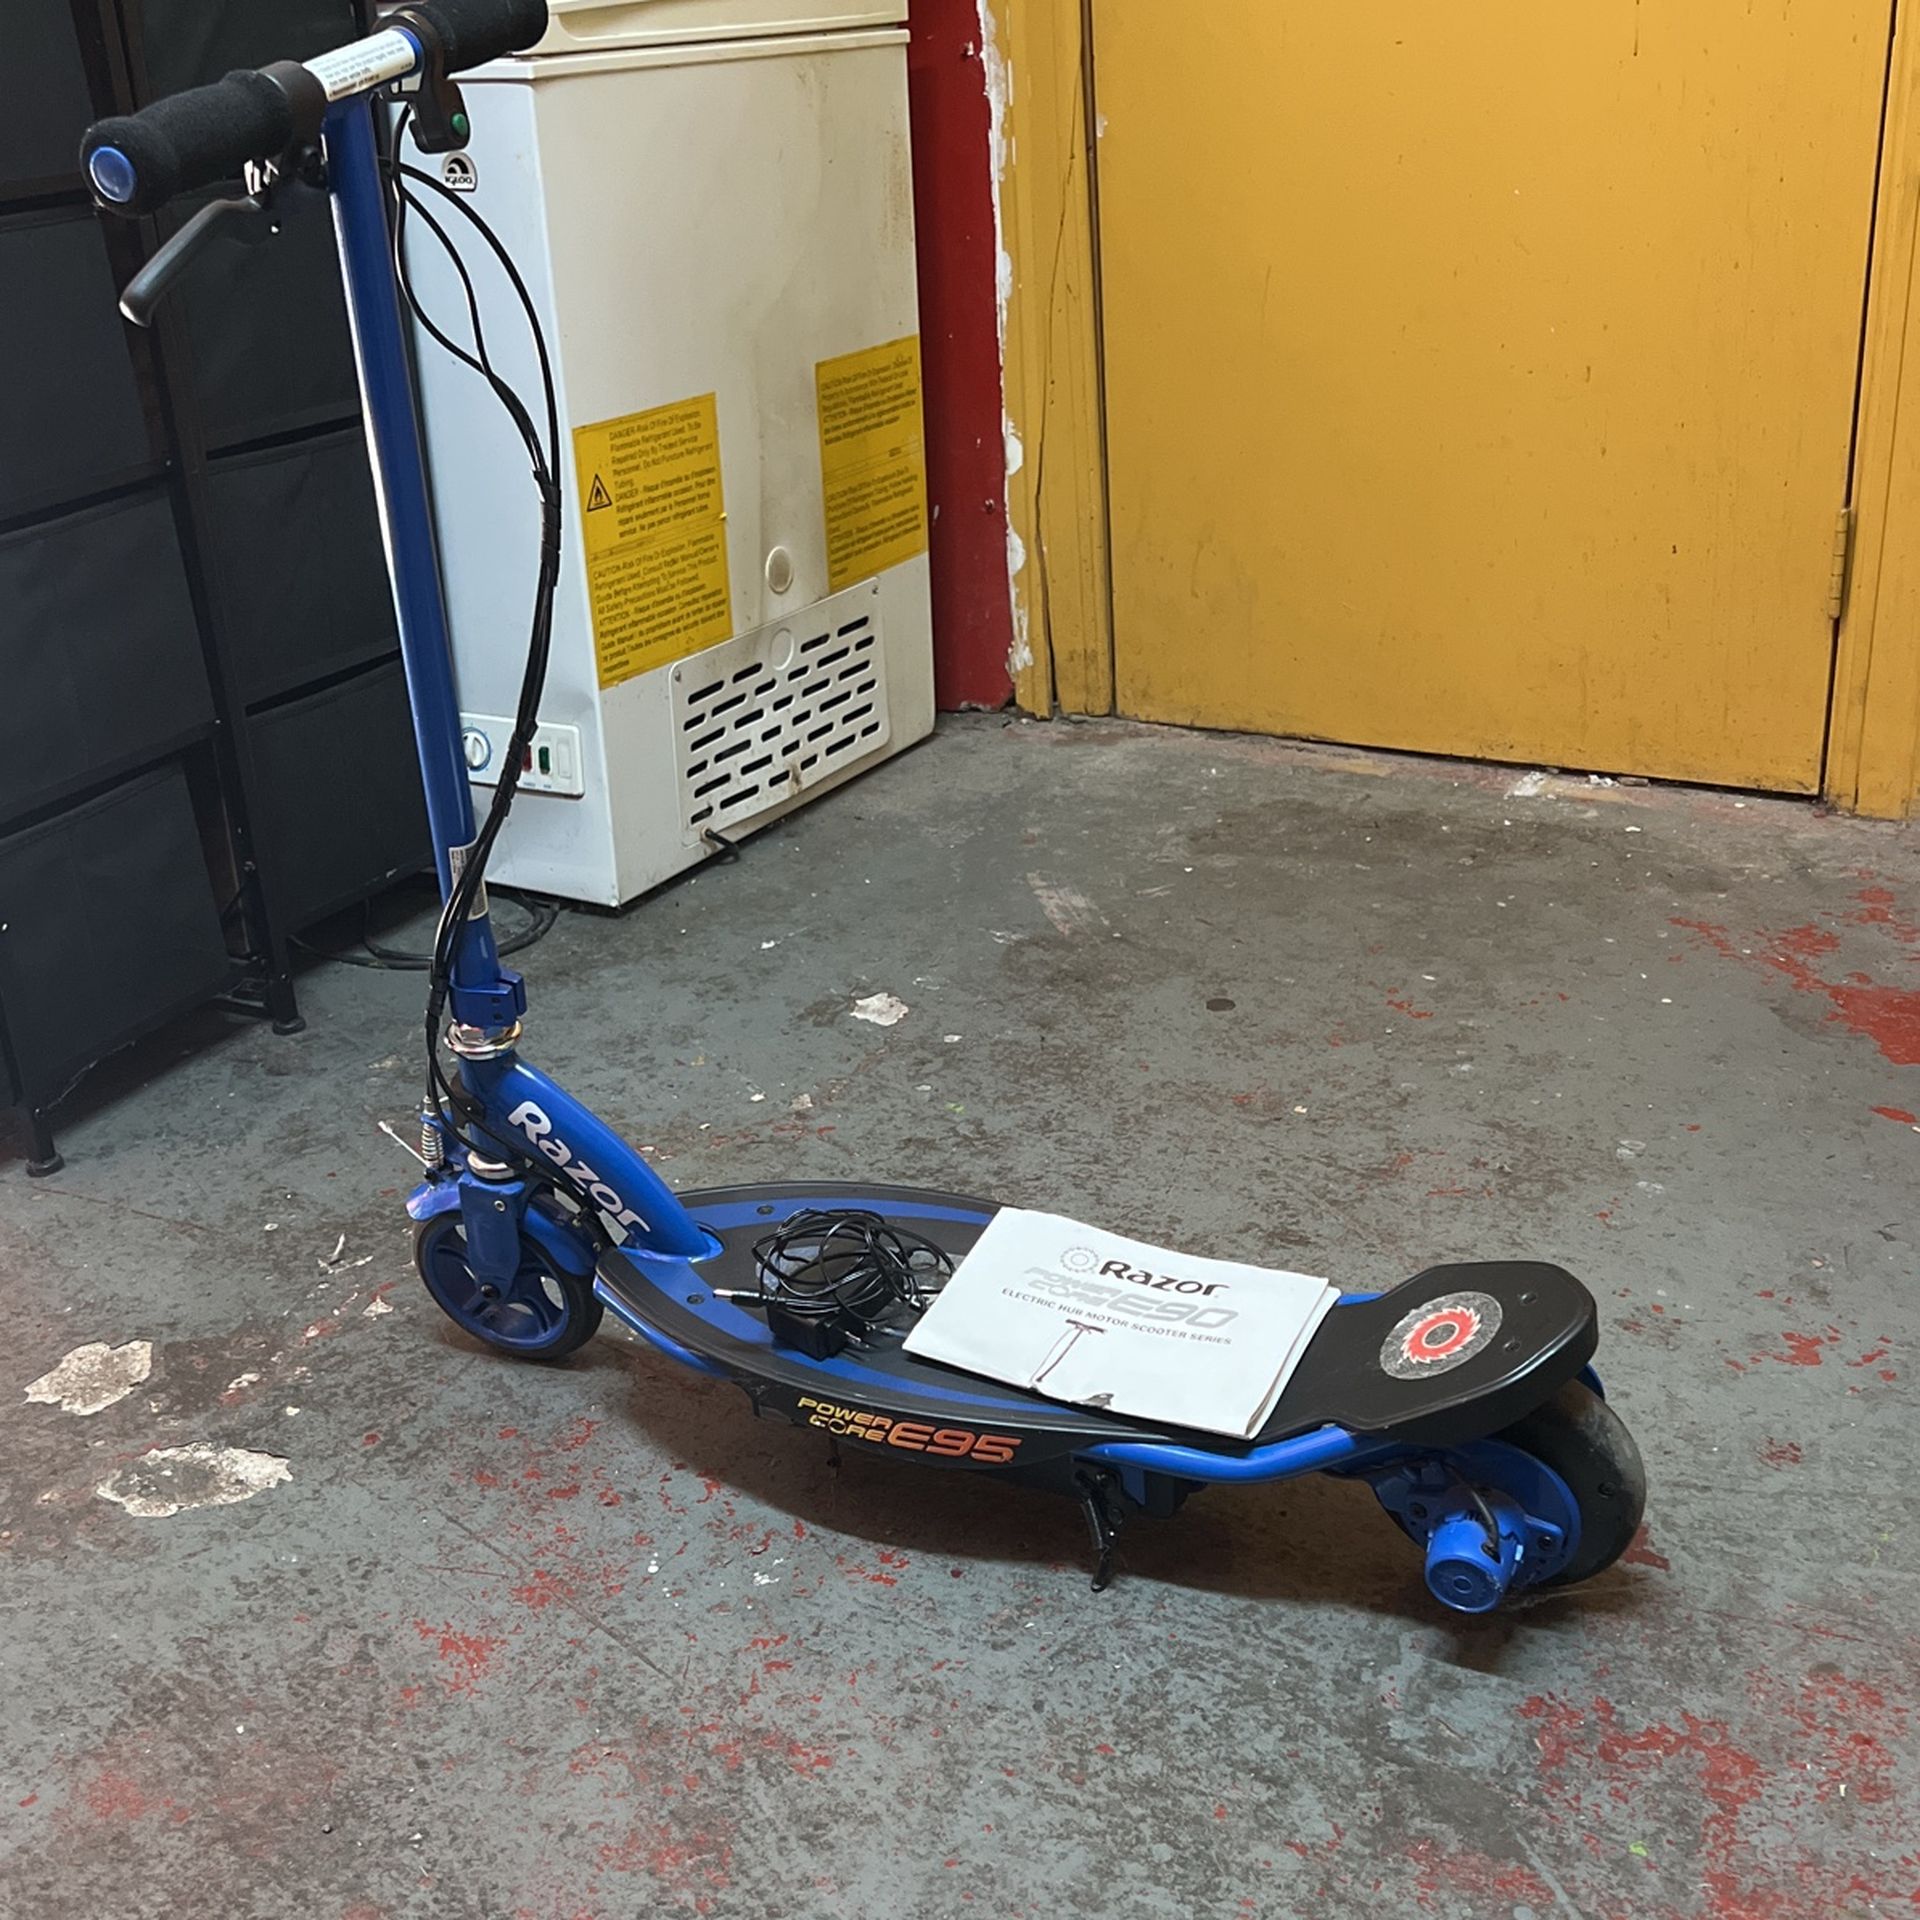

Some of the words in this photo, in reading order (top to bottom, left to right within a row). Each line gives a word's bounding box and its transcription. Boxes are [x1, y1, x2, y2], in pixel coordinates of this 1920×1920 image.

[508, 1101, 650, 1232] Razor
[1099, 1260, 1231, 1296] Razor
[1001, 1288, 1055, 1309] ELECTRIC
[1058, 1304, 1083, 1316] HUB
[1085, 1311, 1129, 1328] MOTOR
[1131, 1323, 1187, 1339] SCOOTER
[1190, 1333, 1232, 1345] SERIES
[1107, 1293, 1239, 1328] E90
[797, 1397, 893, 1430] POWER
[809, 1414, 888, 1442] CORE
[887, 1422, 1023, 1463] E95
